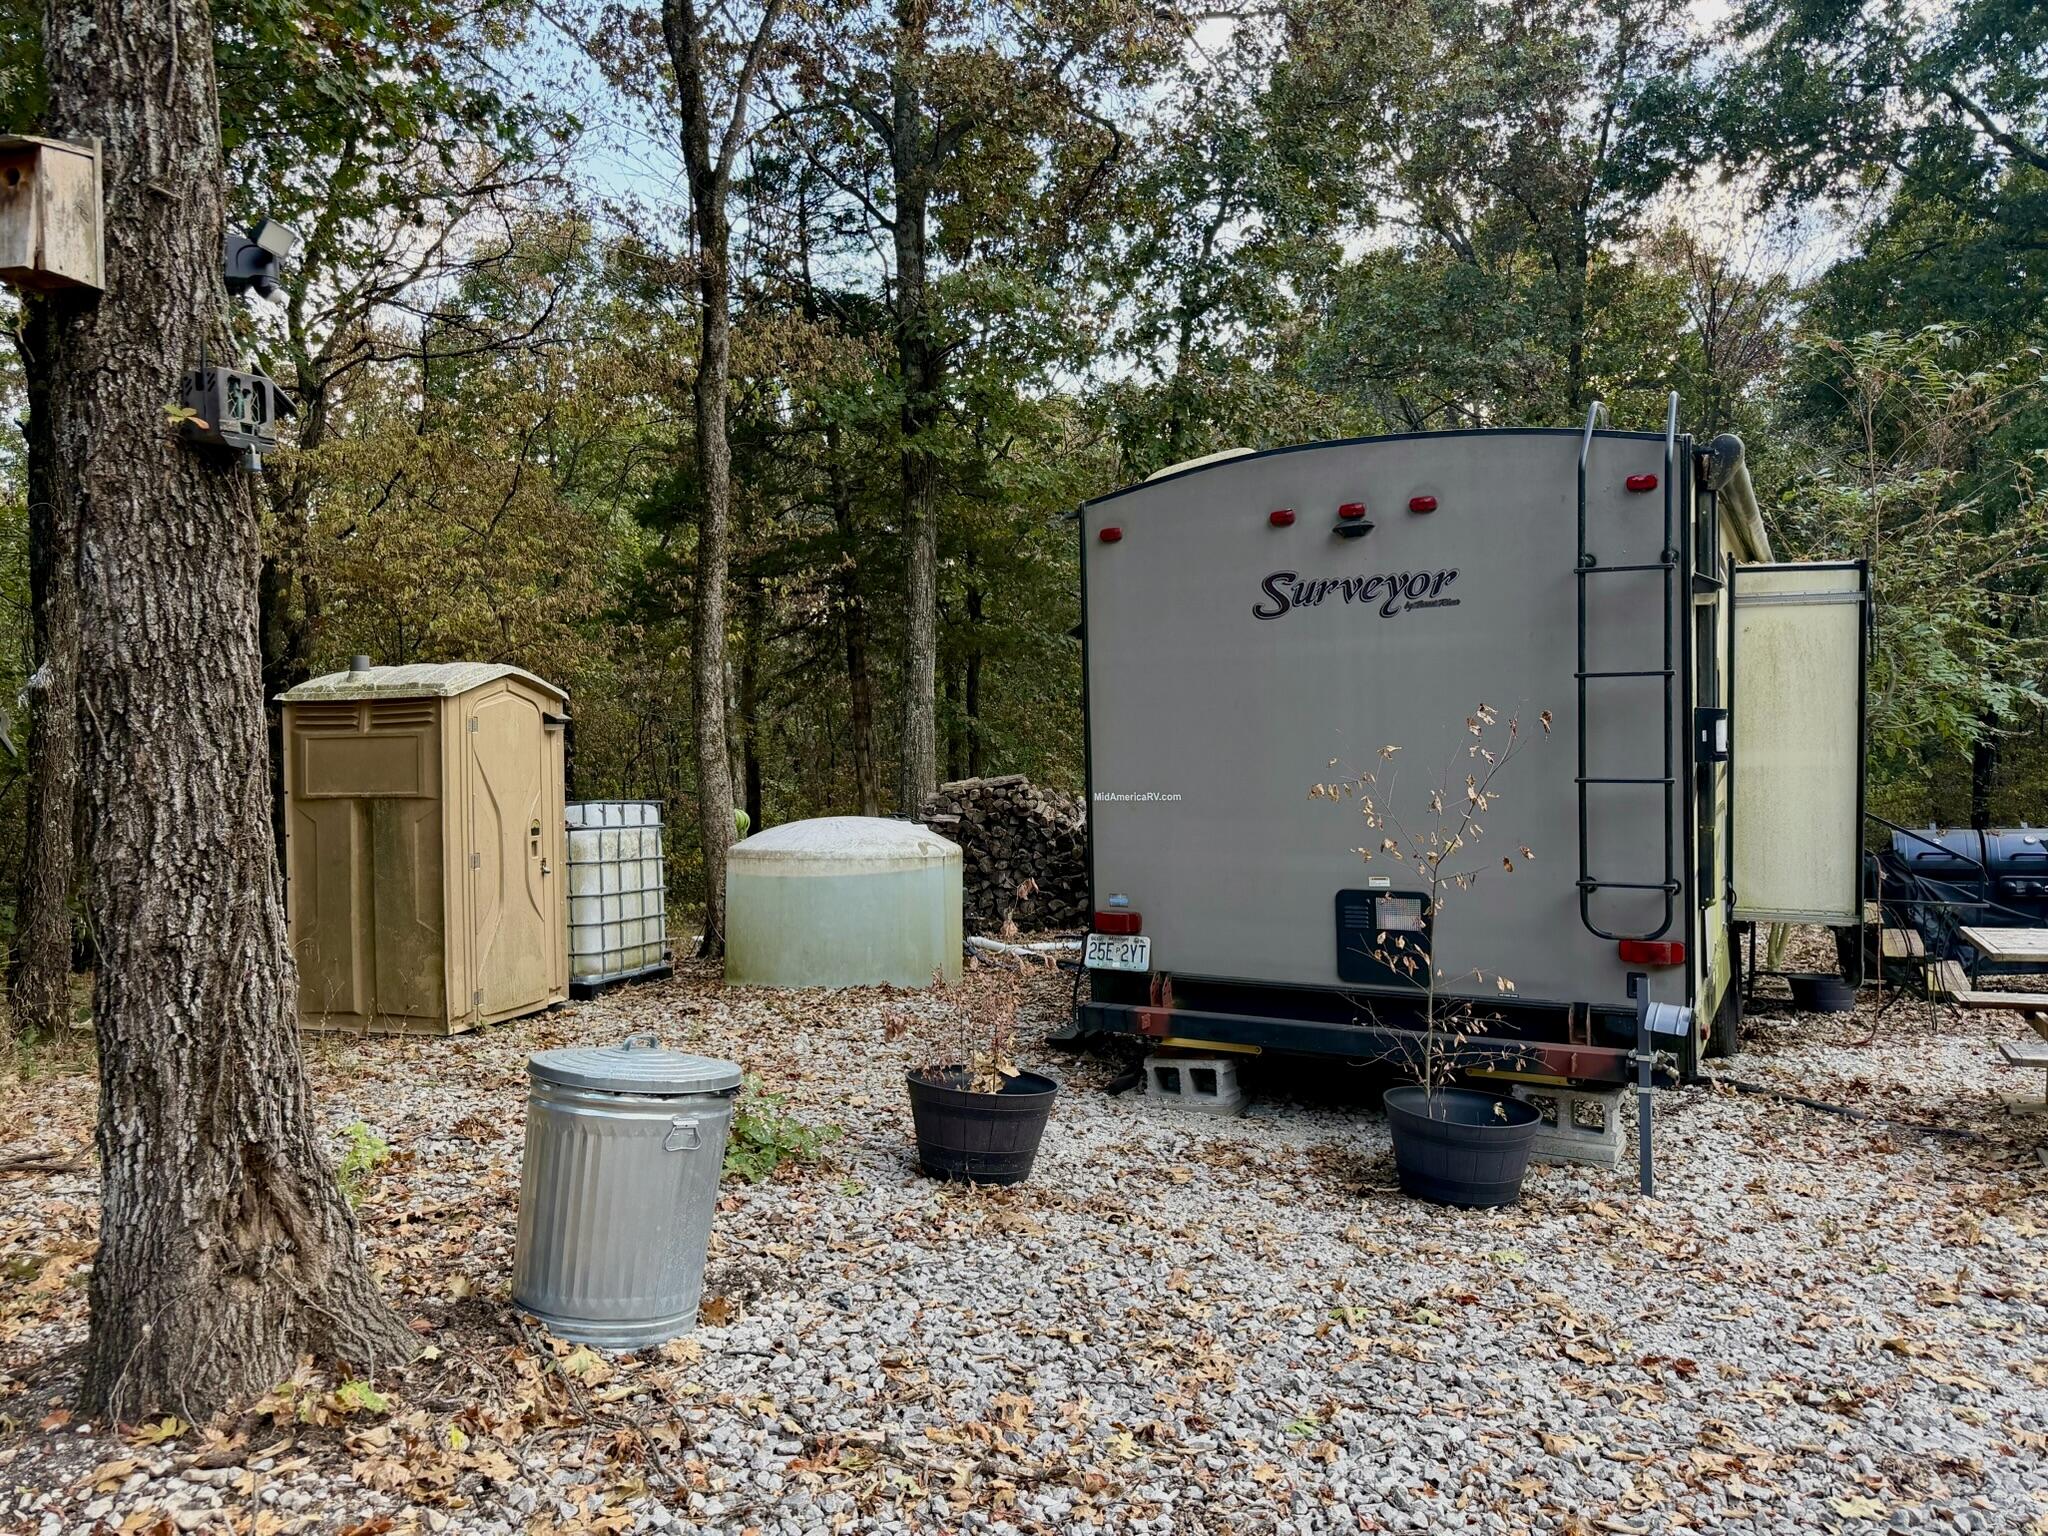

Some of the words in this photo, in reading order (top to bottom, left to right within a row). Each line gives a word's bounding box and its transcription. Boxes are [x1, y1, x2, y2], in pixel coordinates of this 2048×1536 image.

[1252, 567, 1461, 620] Surveyor
[1094, 792, 1182, 801] MidAmericaRV.com
[1088, 941, 1115, 961] 25E
[1120, 943, 1147, 964] 2YT
